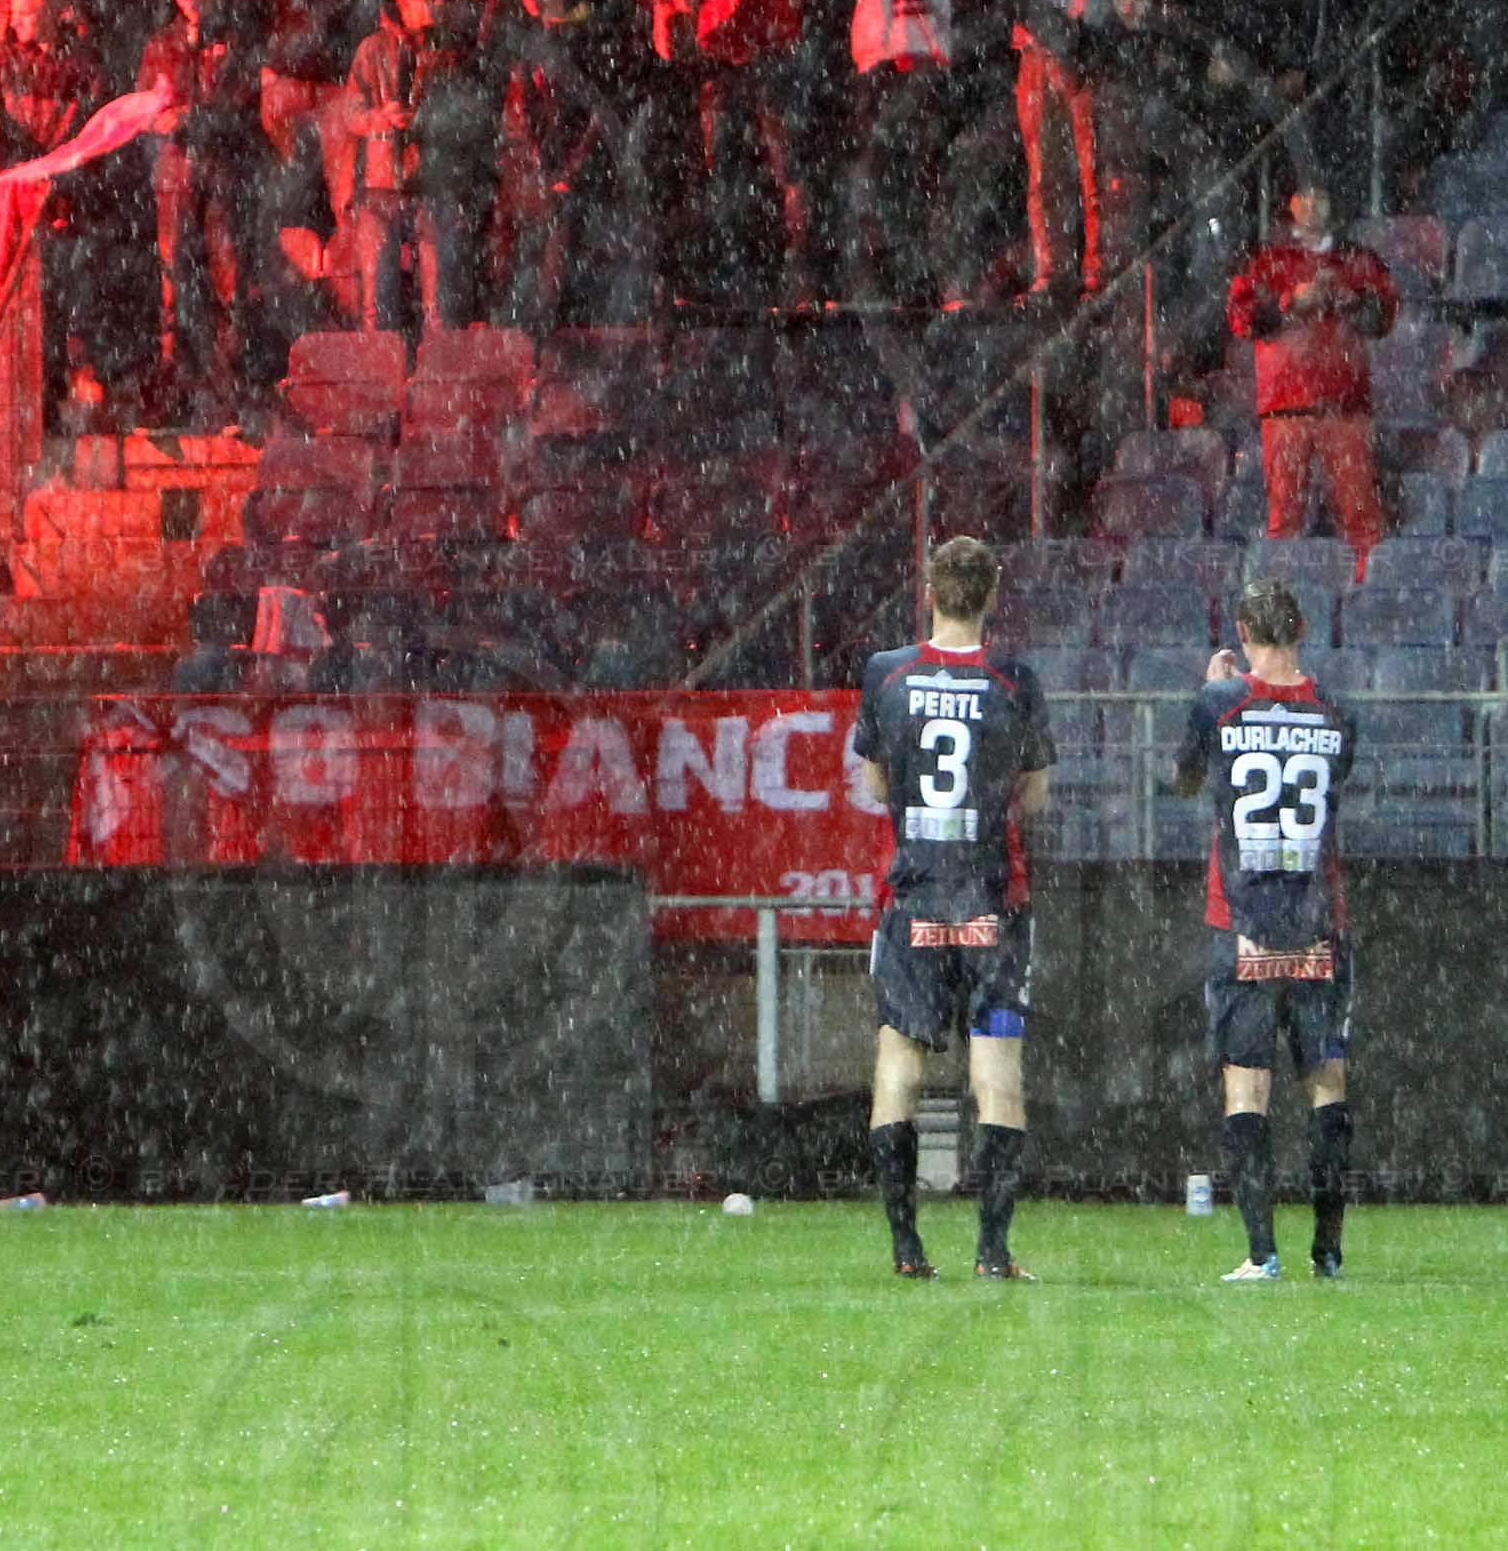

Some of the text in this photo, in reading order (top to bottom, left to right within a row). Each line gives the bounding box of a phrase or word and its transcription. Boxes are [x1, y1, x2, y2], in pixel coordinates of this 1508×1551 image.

[908, 690, 983, 719] PERTL
[919, 718, 971, 809] 3
[1220, 725, 1342, 754] DURLACHER
[1230, 751, 1331, 840] 23
